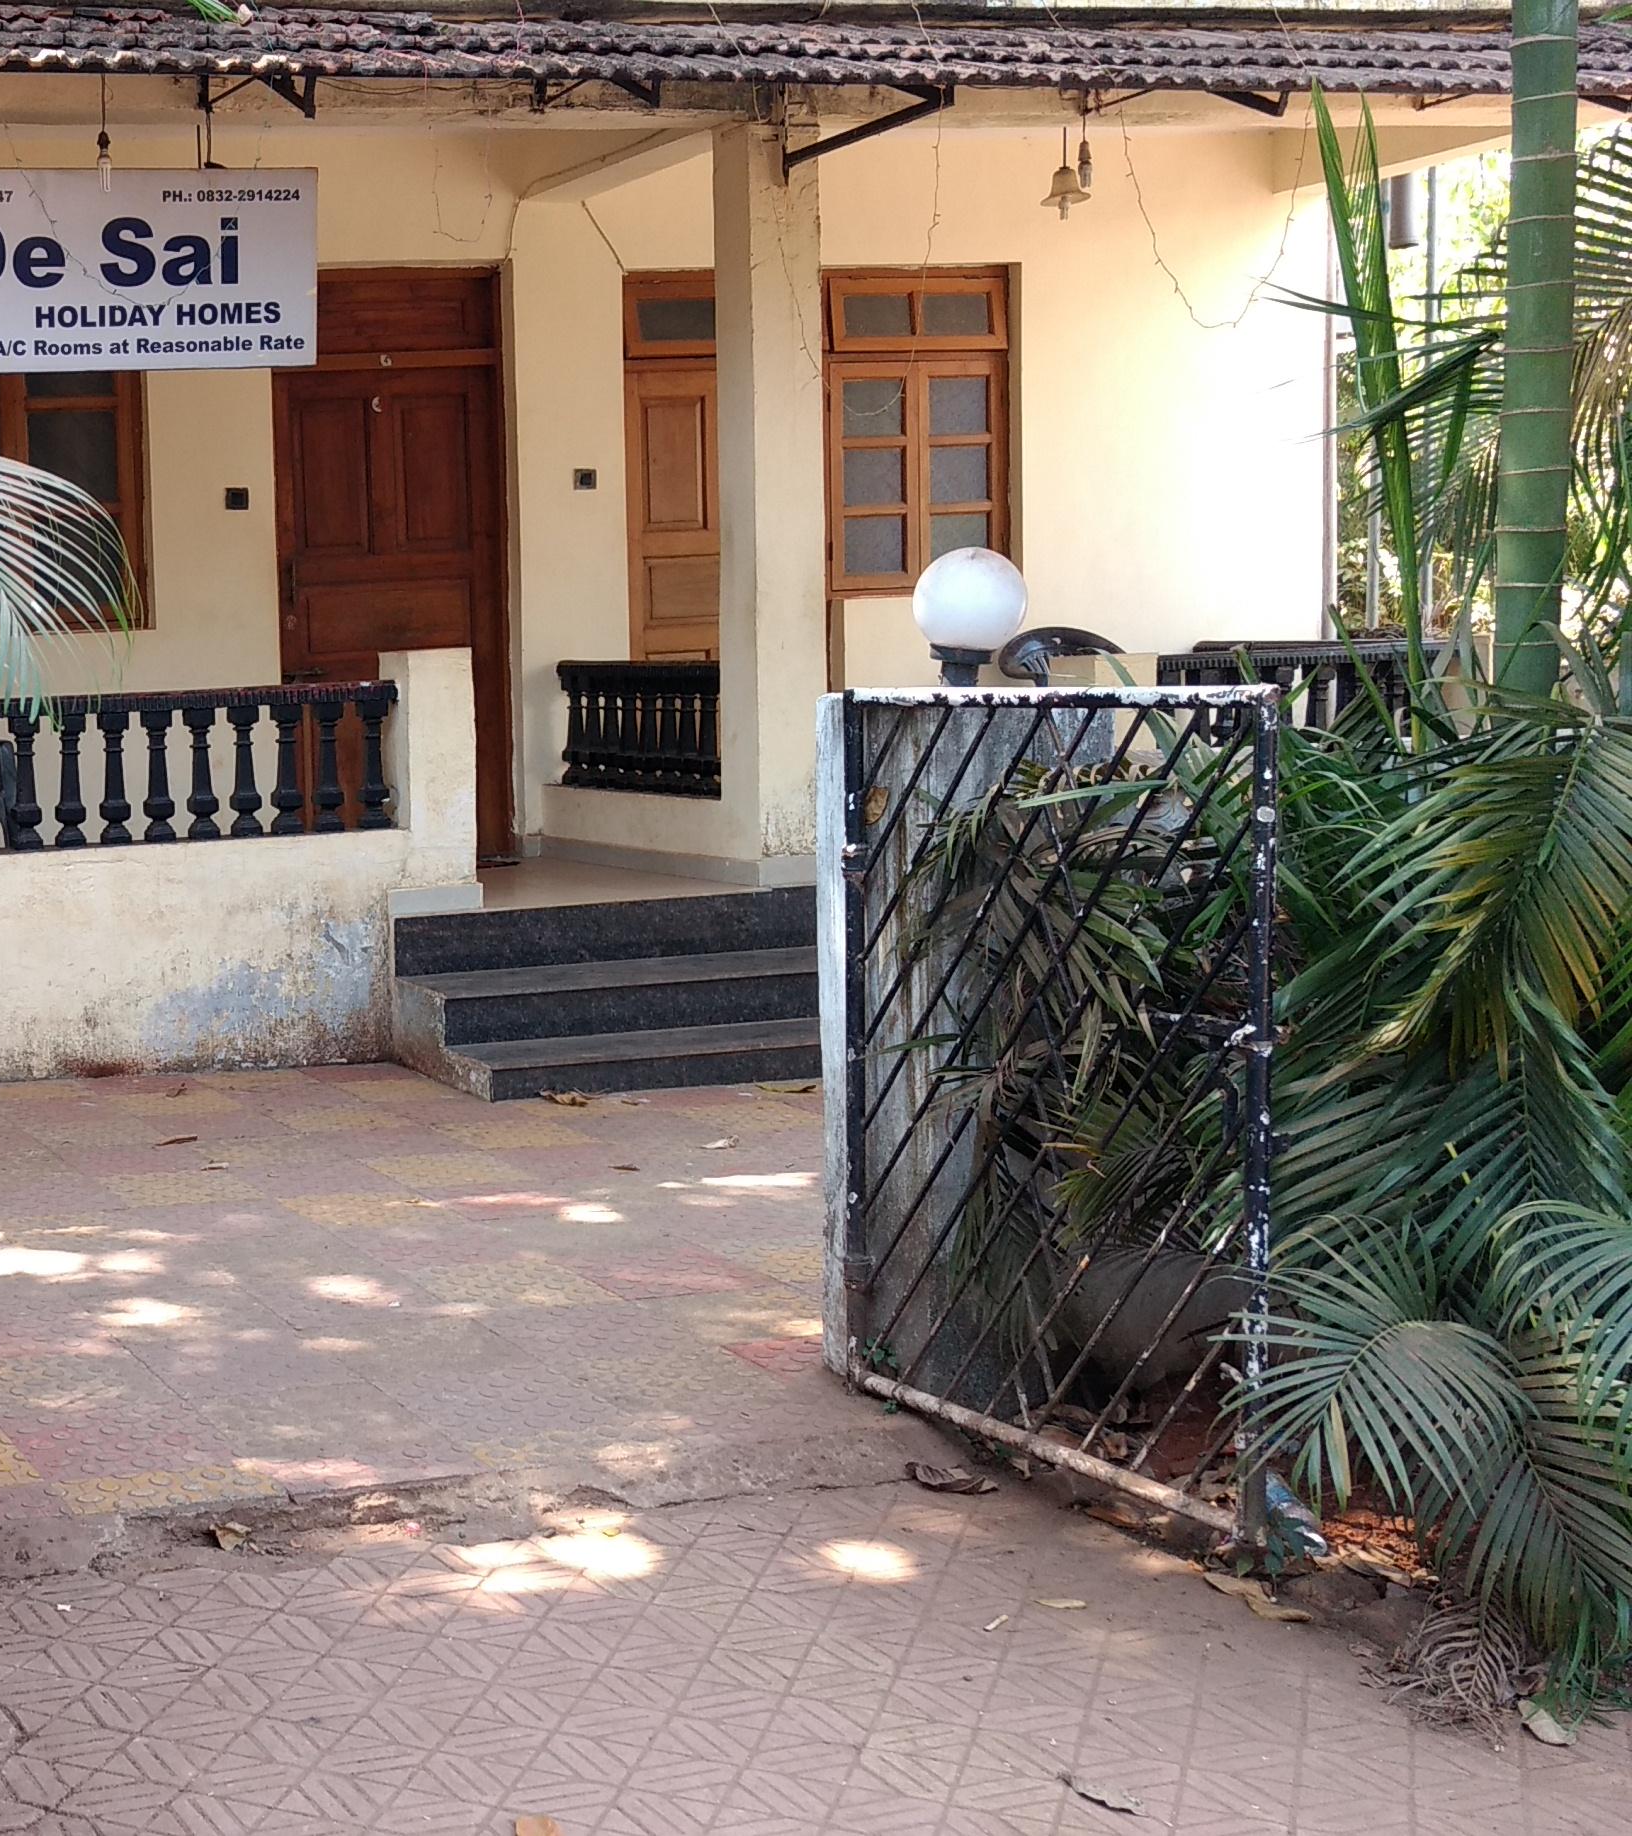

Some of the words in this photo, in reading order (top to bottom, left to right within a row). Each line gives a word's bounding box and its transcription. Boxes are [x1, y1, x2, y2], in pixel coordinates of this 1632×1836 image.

[162, 190, 192, 203] PH.:
[196, 189, 301, 203] 0832-2914224
[100, 217, 238, 286] Sai
[35, 304, 166, 328] HOLIDAY
[177, 302, 281, 325] HOMES
[34, 339, 102, 356] Rooms
[110, 339, 129, 354] at
[137, 336, 253, 354] Reasonable
[260, 335, 305, 351] Rate
